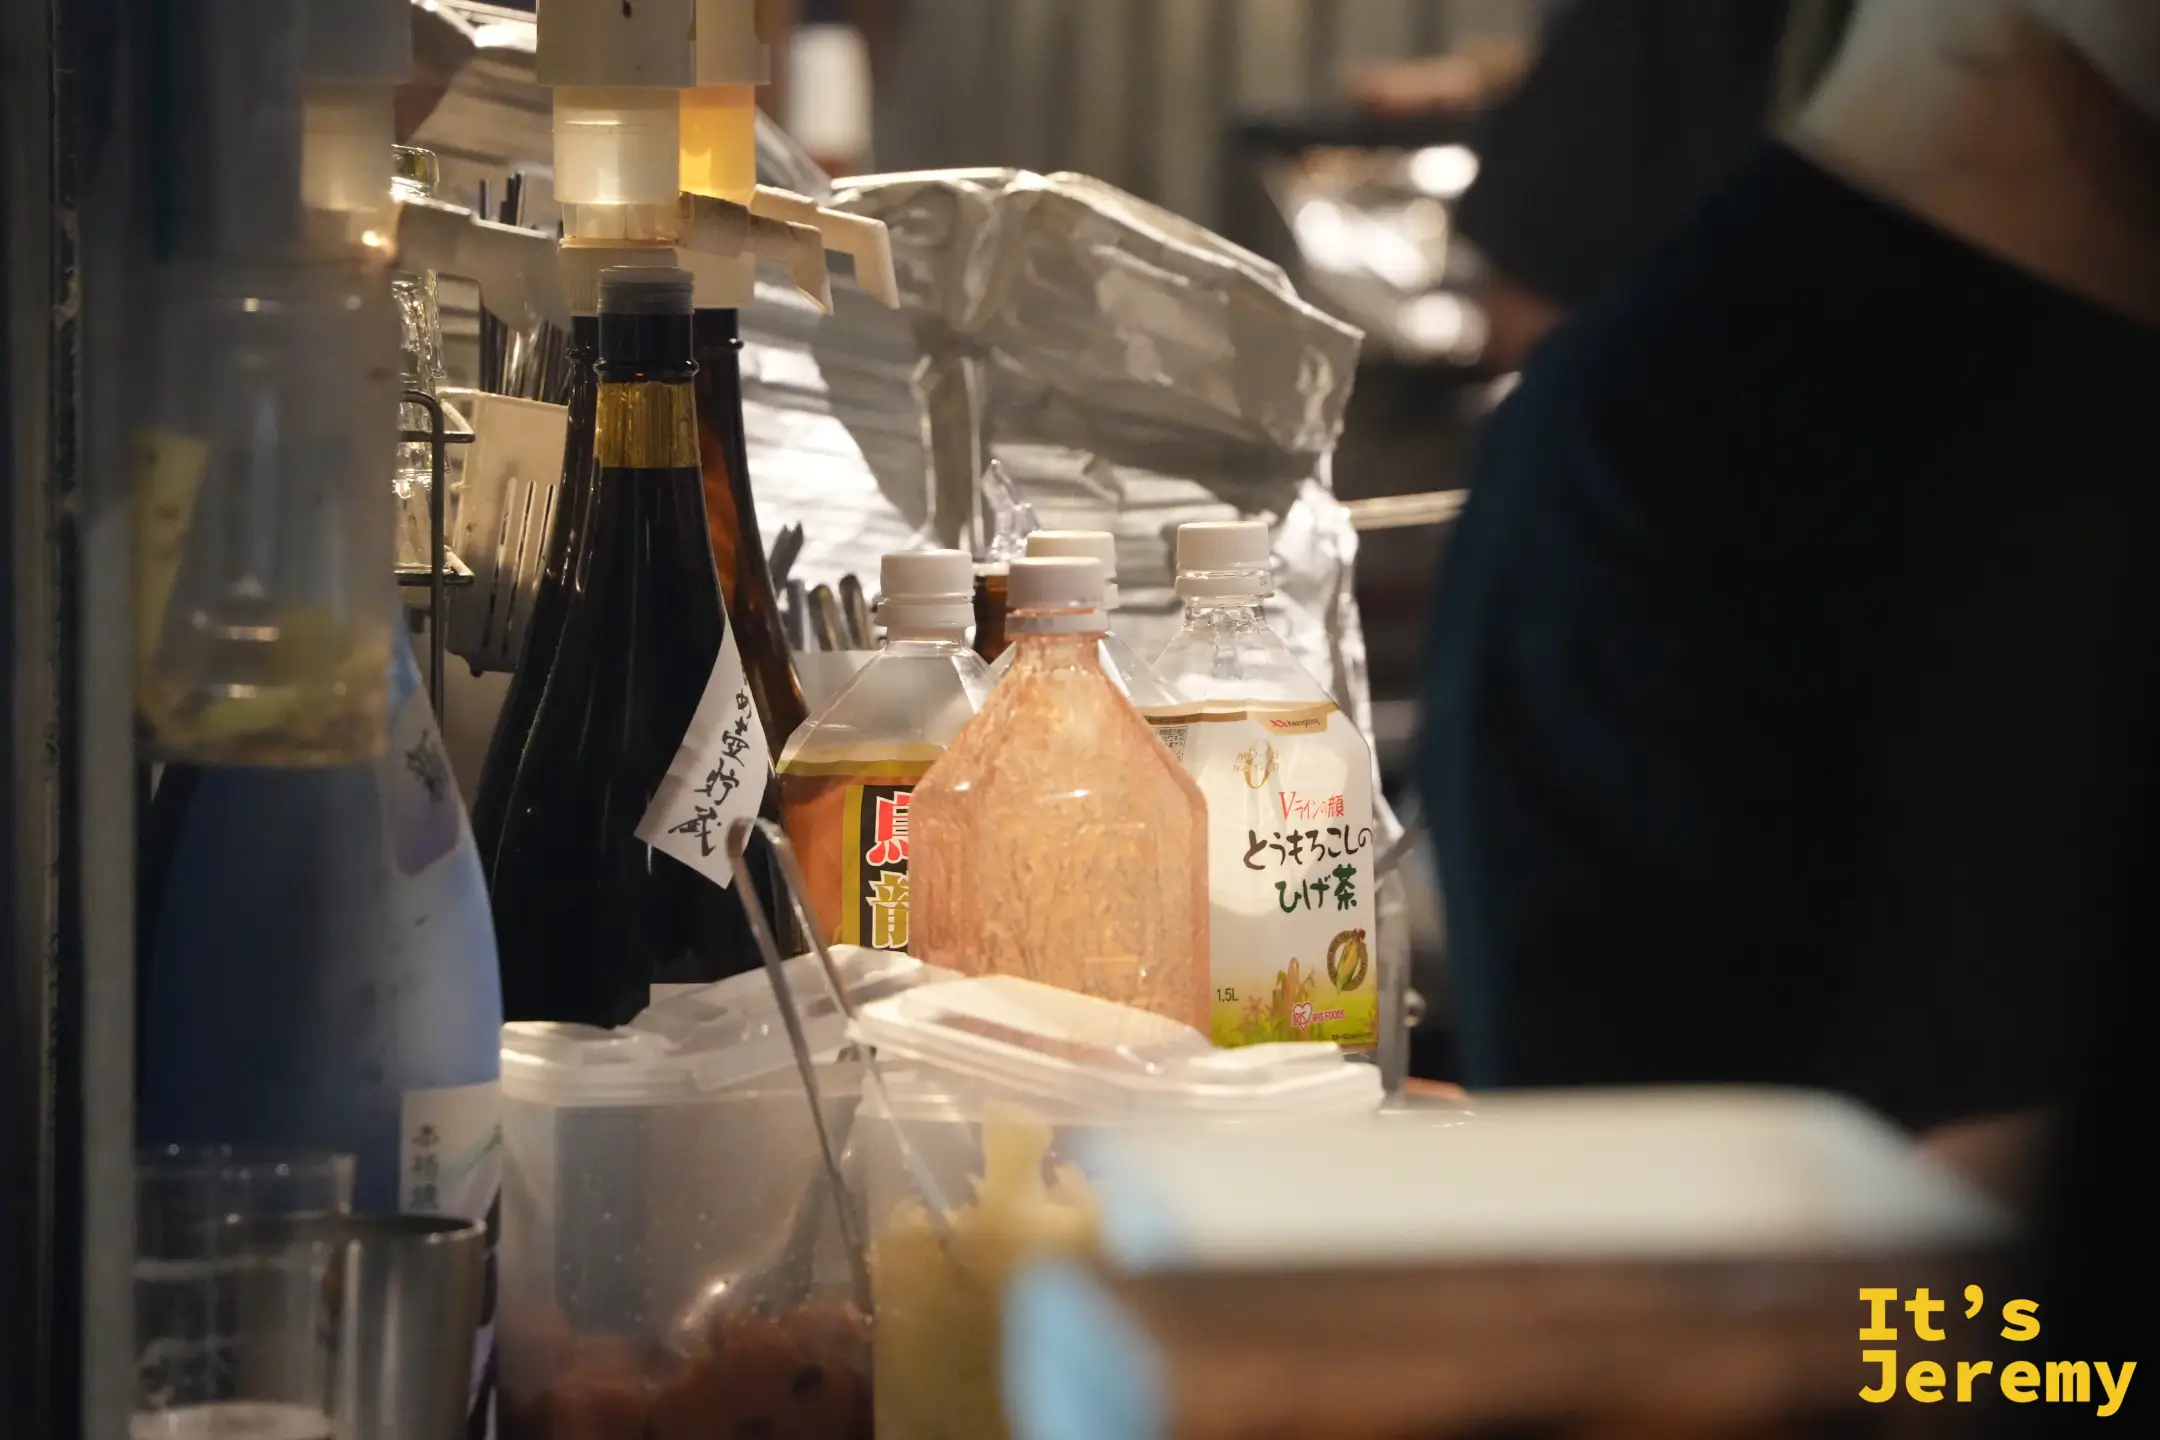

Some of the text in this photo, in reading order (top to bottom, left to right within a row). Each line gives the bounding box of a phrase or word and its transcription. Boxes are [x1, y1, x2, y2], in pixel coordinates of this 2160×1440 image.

[1278, 791, 1344, 820] Vラインの顔
[1243, 824, 1373, 870] とうもろこしの
[1274, 863, 1357, 913] ひげ茶
[1216, 987, 1239, 1003] 1.5L
